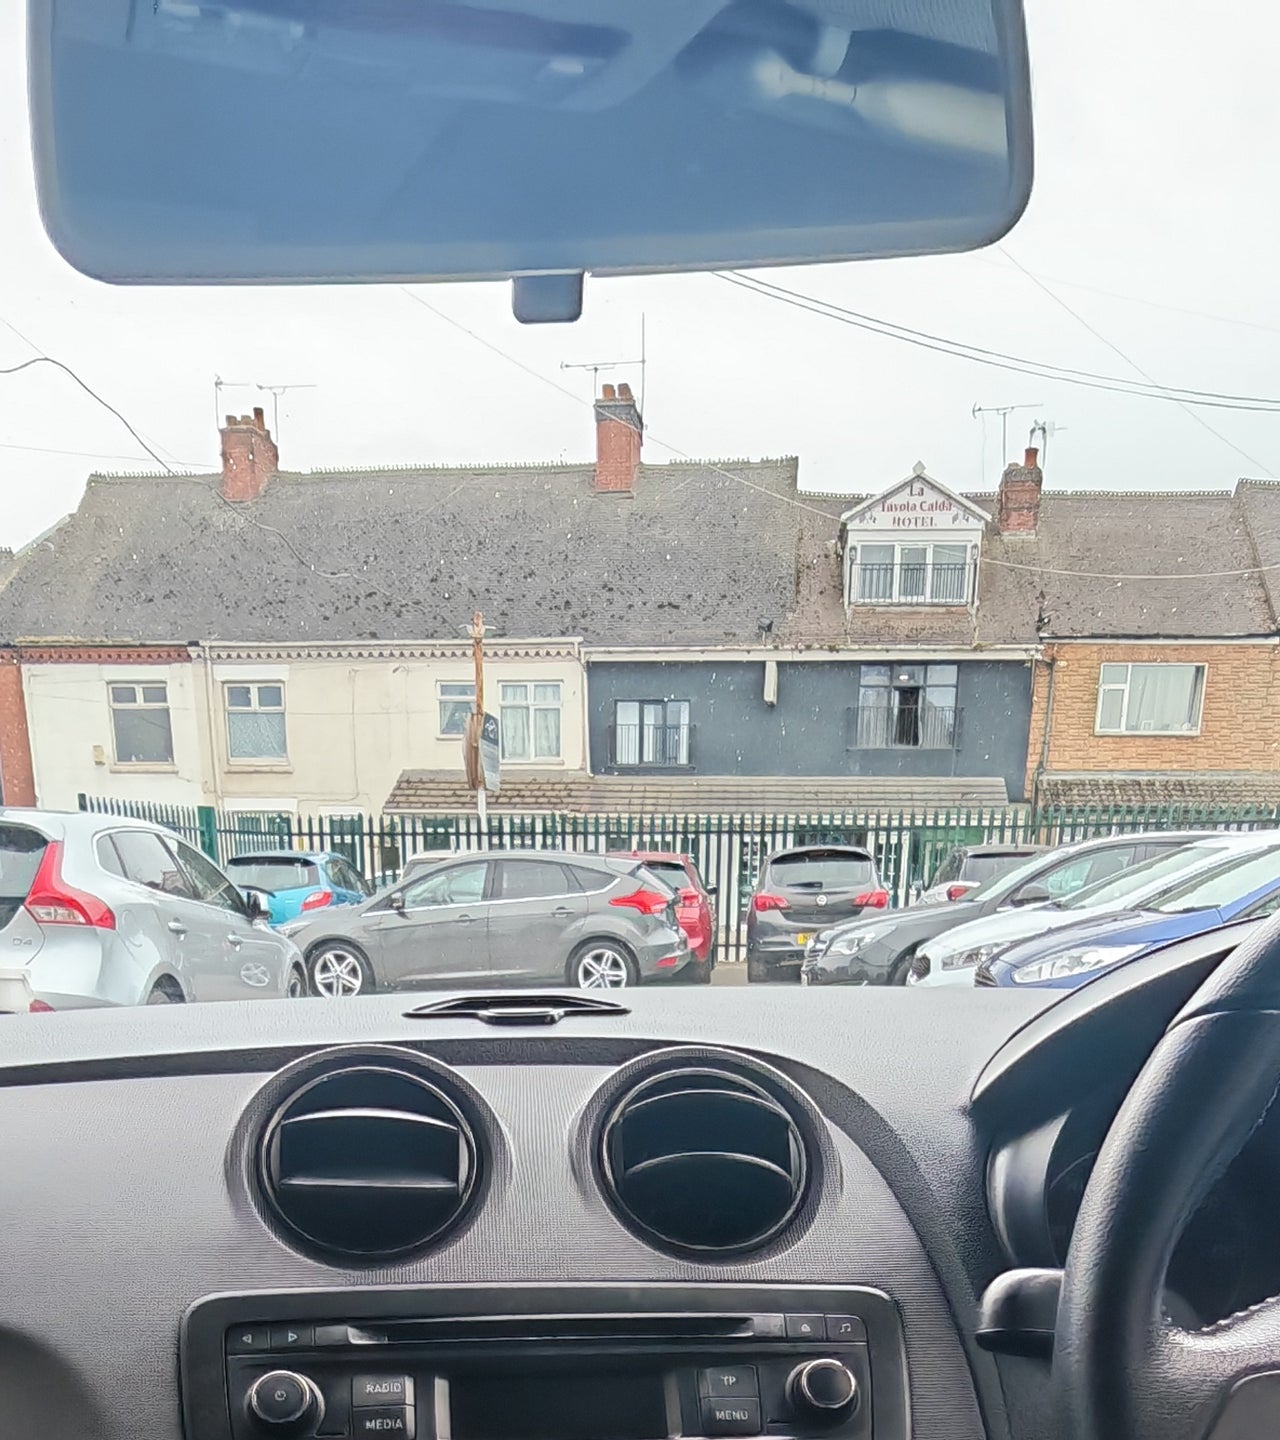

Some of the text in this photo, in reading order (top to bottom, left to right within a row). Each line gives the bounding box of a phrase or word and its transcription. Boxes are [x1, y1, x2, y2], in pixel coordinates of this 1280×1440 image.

[909, 483, 925, 497] La
[881, 499, 953, 513] Tavola Calda
[892, 516, 938, 528] HOTEL
[12, 937, 33, 946] D4
[720, 1375, 737, 1386] TP
[366, 1382, 402, 1393] RADIO
[715, 1410, 749, 1421] MENU
[365, 1418, 404, 1430] MEDIA
